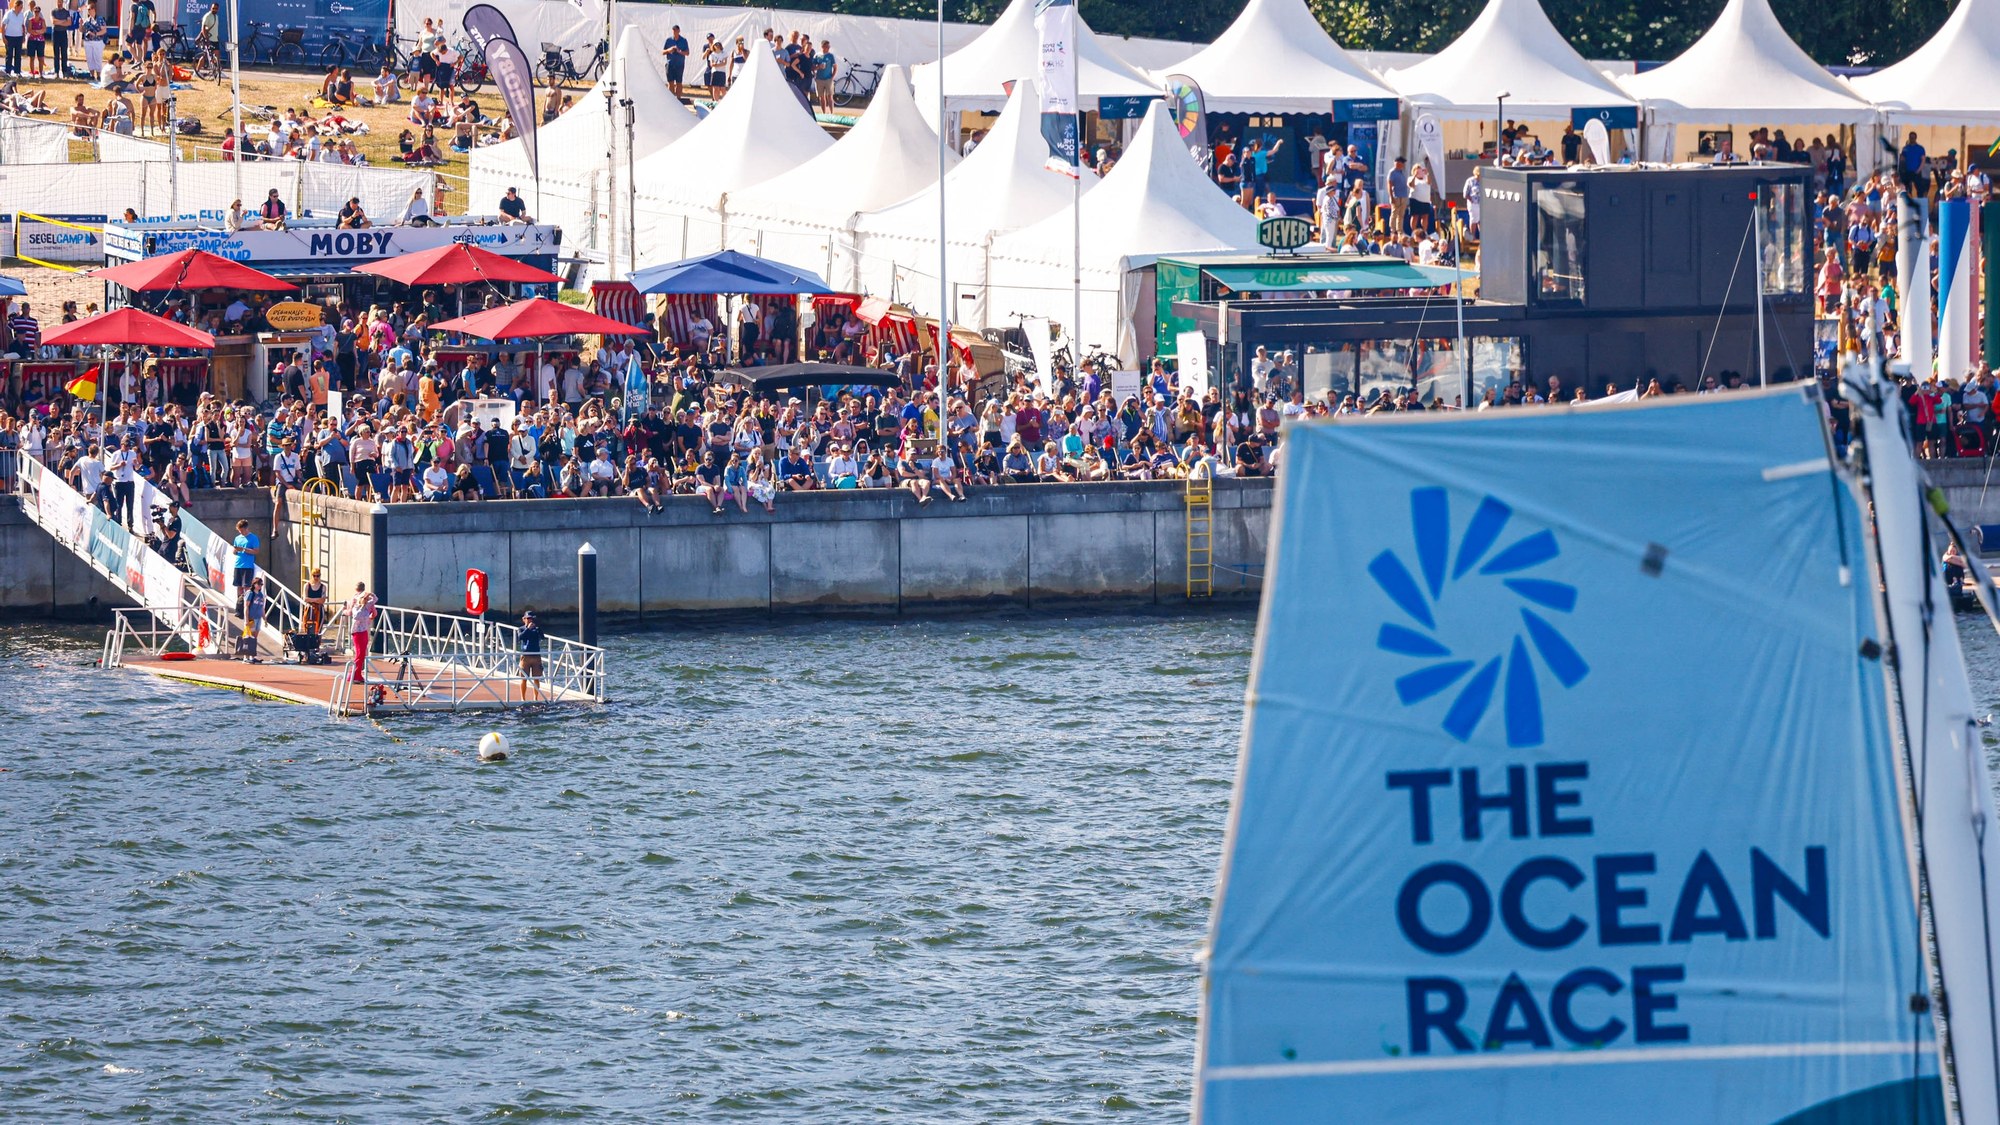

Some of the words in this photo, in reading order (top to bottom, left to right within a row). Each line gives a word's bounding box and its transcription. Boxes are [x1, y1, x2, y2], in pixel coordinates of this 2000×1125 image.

[1484, 188, 1520, 202] VOLVO
[29, 233, 84, 244] SEGELCAMP
[310, 232, 394, 256] MOBY
[1262, 220, 1309, 247] JEVER
[1386, 760, 1594, 845] THE
[1396, 844, 1833, 956] OCEAN
[1406, 964, 1691, 1055] RACE
